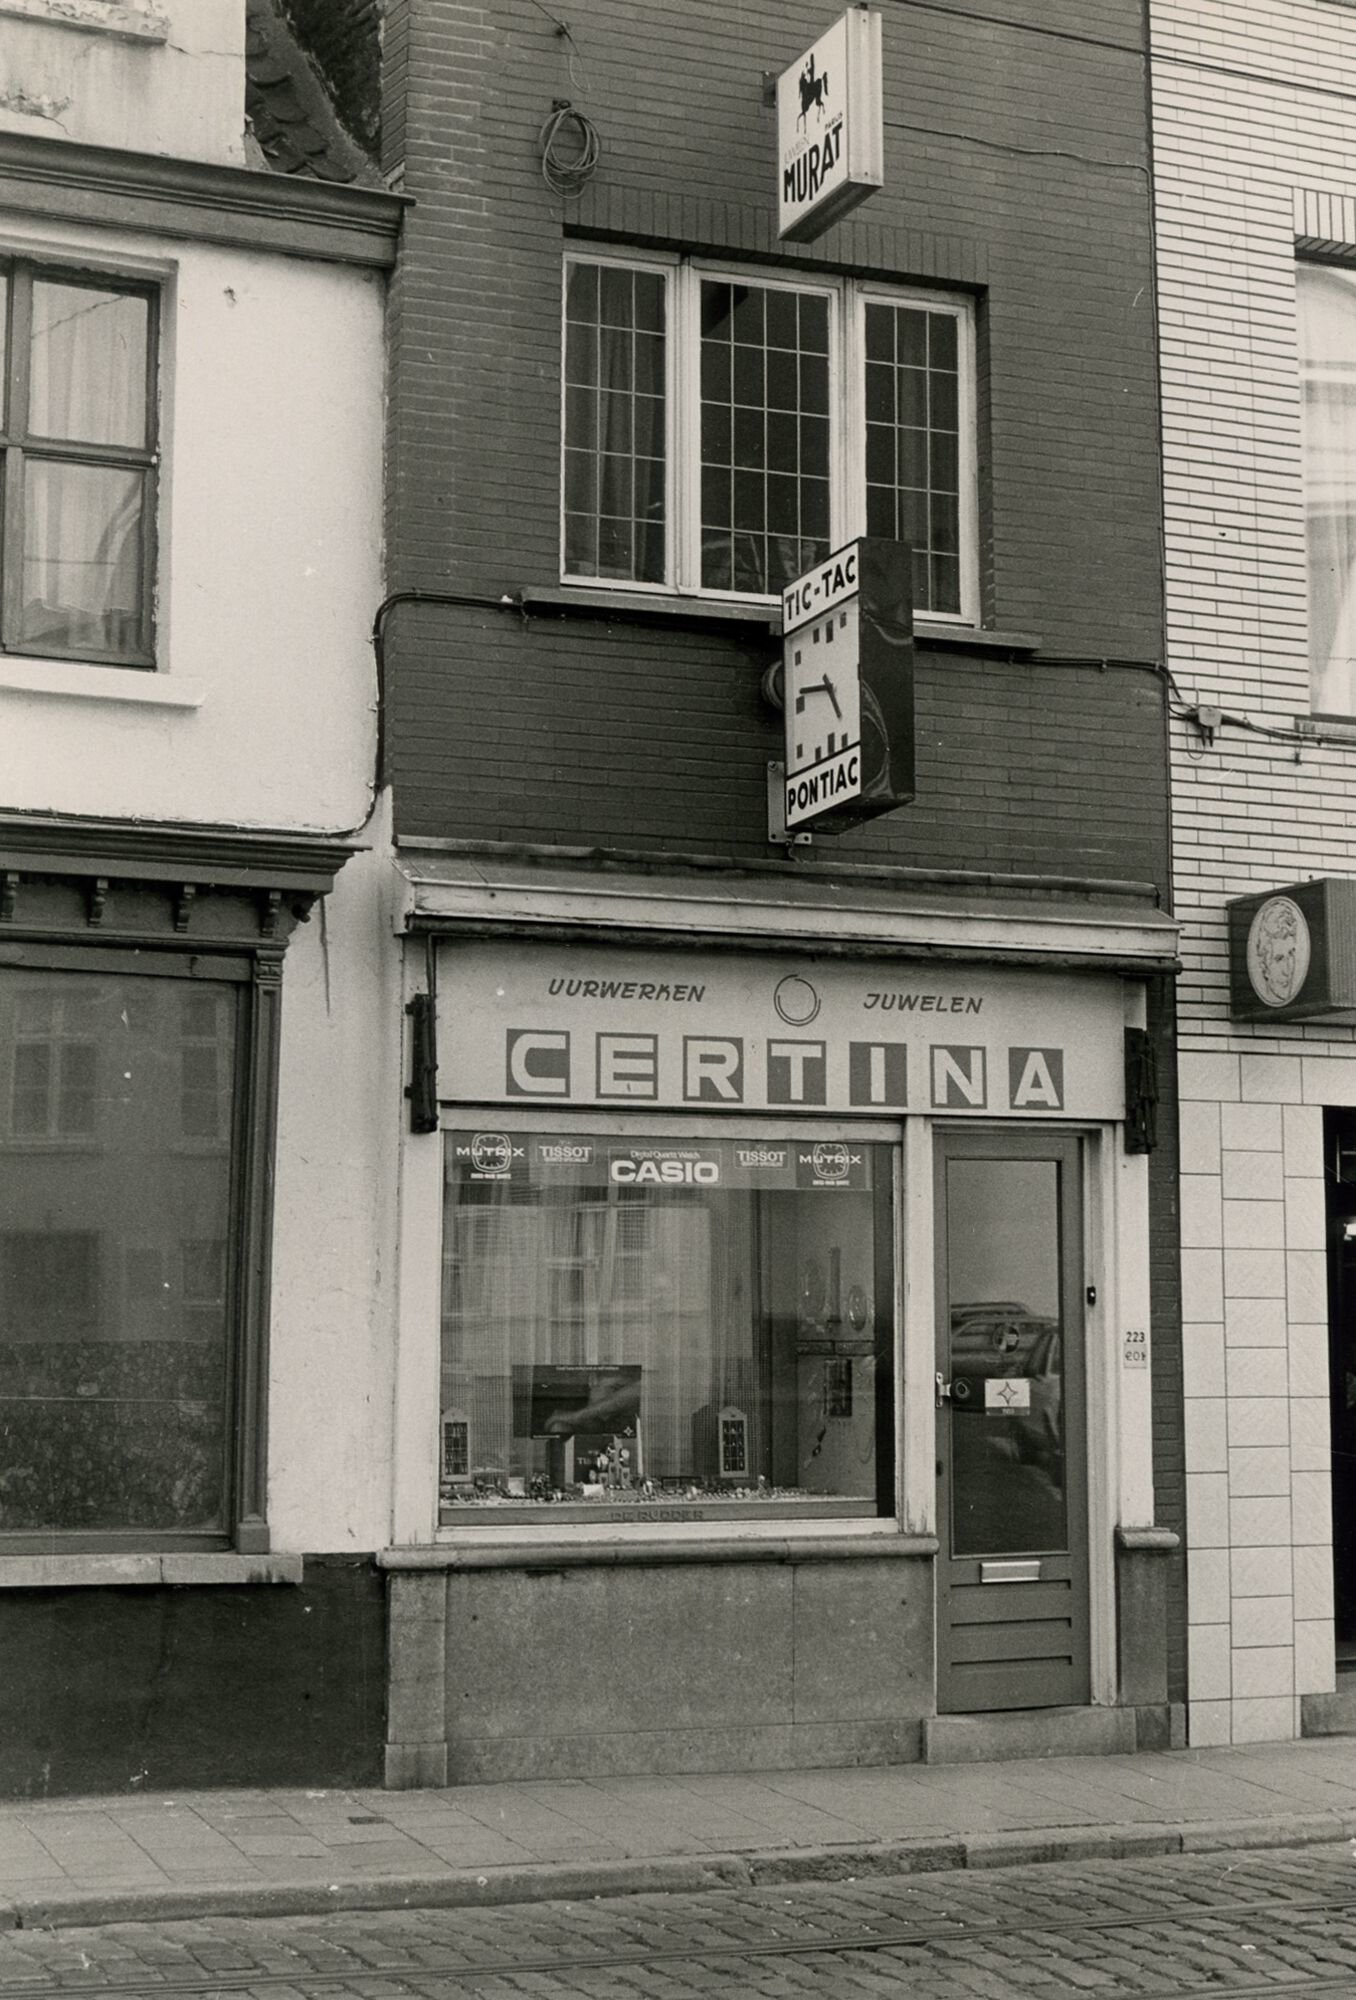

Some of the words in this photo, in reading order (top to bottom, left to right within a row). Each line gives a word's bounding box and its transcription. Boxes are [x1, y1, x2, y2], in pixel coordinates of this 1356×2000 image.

[784, 121, 842, 203] MURAT
[785, 555, 856, 620] TIC-TAC
[787, 757, 858, 815] PONTIAC
[548, 978, 705, 1003] UURWERKEN
[863, 992, 983, 1014] JUWELEN
[508, 1030, 1062, 1108] CERTINA
[456, 1146, 525, 1158] MUTRIX
[538, 1145, 592, 1158] TISSOT
[736, 1150, 787, 1162] TISSOT
[799, 1154, 861, 1164] MUTRIX
[611, 1160, 719, 1184] CASIO
[1126, 1331, 1145, 1343] 223
